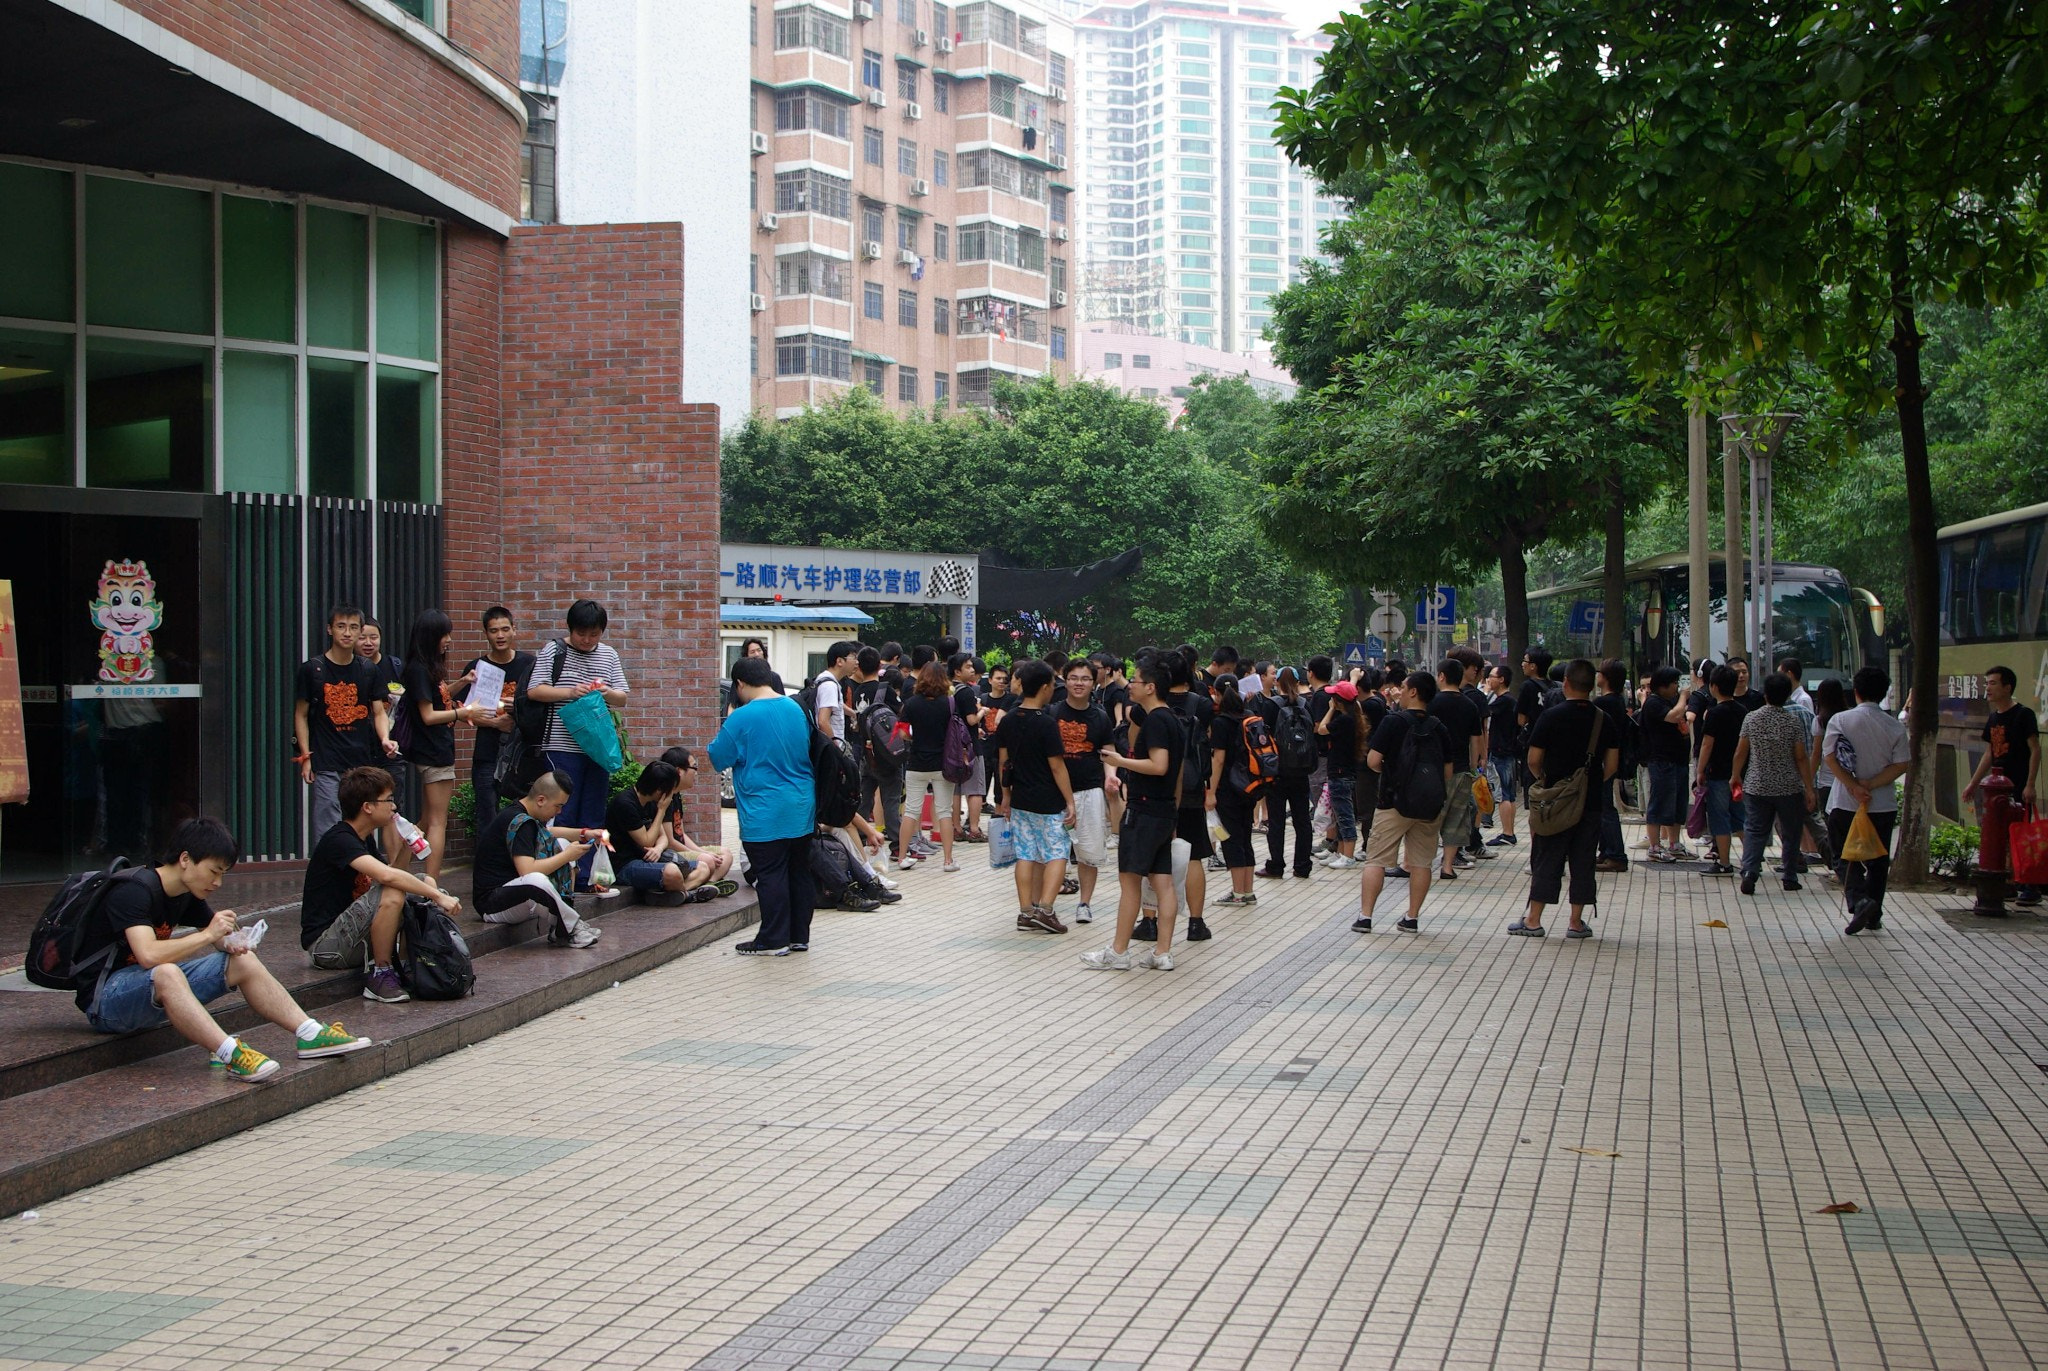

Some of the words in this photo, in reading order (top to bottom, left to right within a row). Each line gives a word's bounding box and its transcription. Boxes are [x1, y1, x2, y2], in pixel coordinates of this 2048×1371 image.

[720, 562, 921, 595] 一路顺汽车护理经营部
[1426, 591, 1447, 619] P
[964, 607, 974, 650] 名车保
